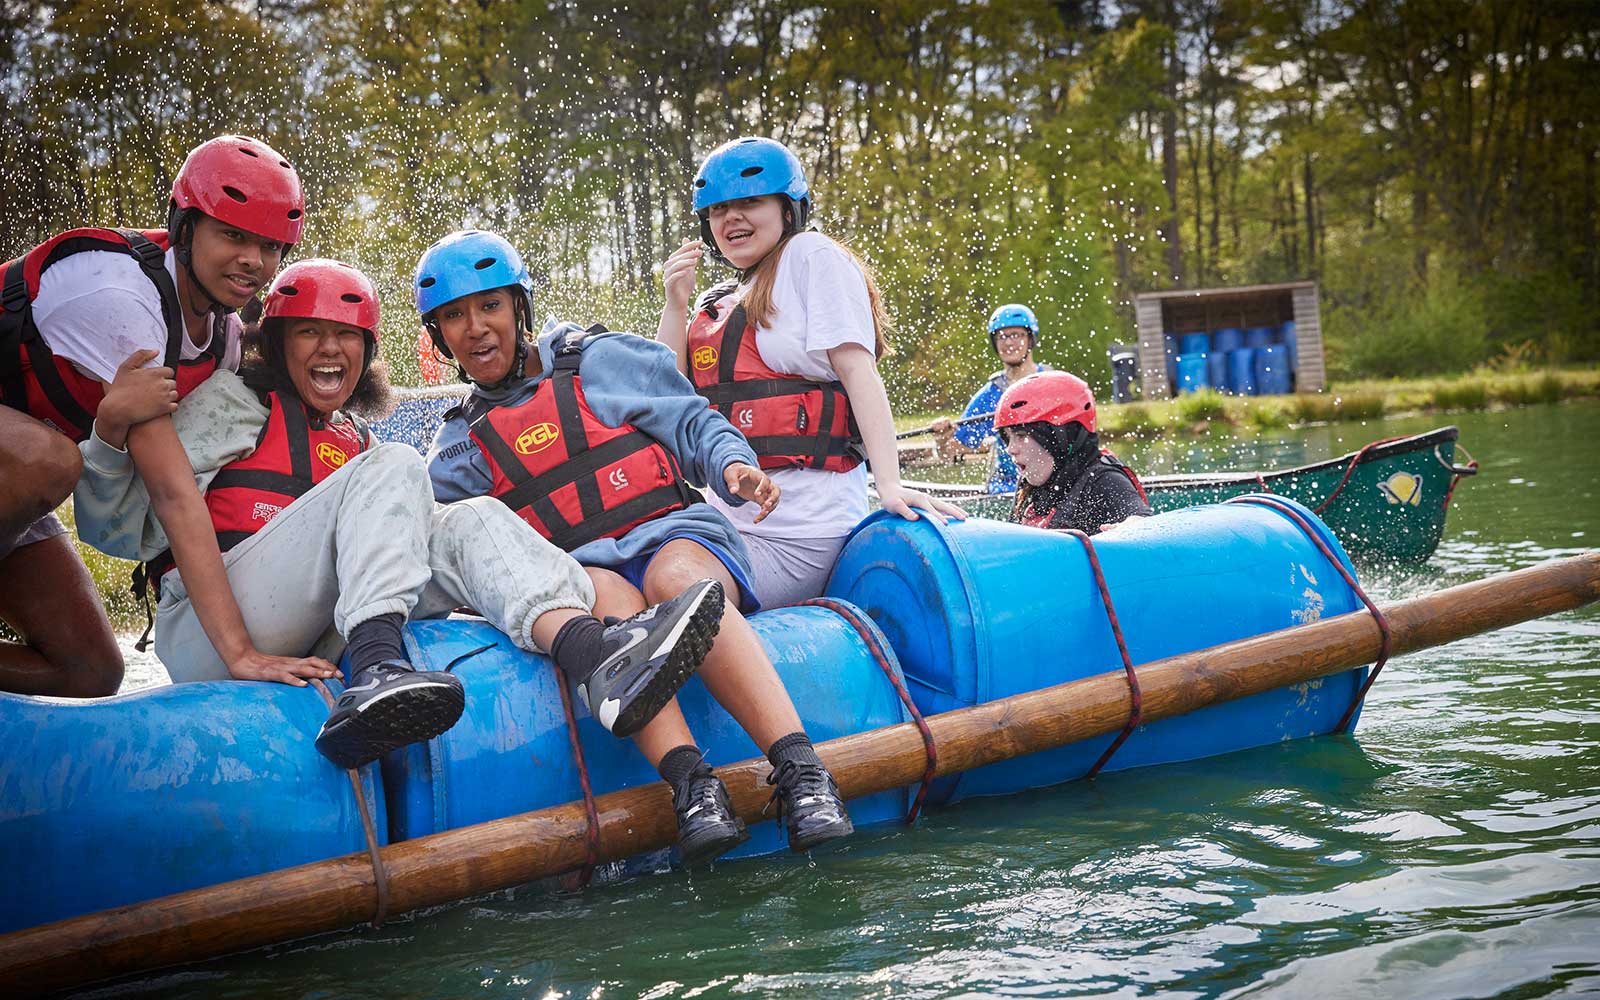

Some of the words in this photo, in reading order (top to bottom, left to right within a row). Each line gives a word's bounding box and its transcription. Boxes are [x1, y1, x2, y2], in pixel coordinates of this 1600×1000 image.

[694, 347, 718, 369] PGL
[739, 409, 753, 424] CE
[518, 423, 558, 454] PGL
[609, 467, 628, 486] CE
